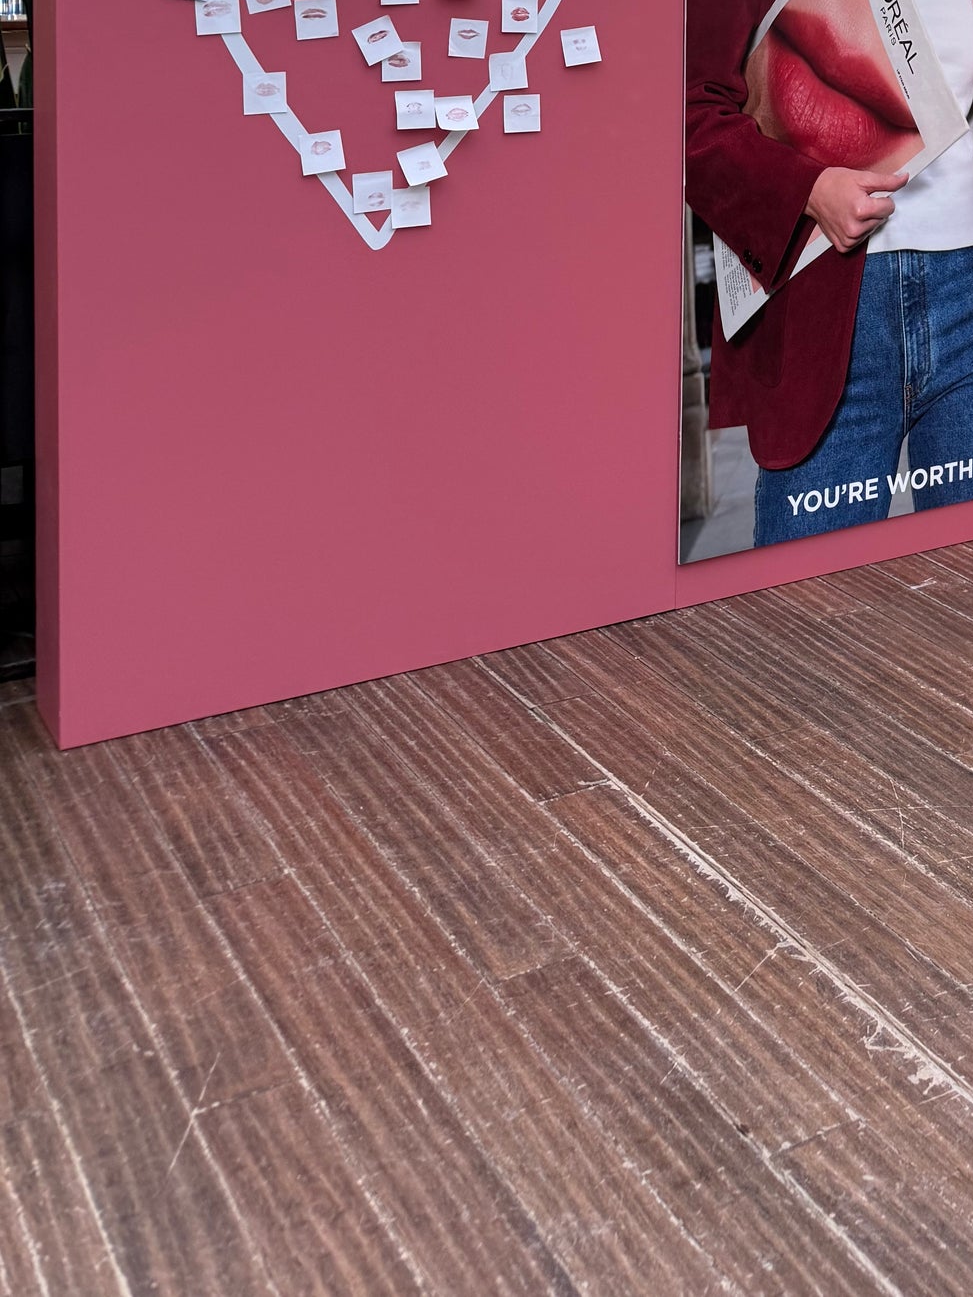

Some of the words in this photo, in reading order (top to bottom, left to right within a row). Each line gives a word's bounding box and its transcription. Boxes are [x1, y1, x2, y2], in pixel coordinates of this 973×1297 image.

[880, 6, 896, 45] PARIS
[787, 477, 879, 516] YOU'RE
[886, 458, 973, 496] WORTH
